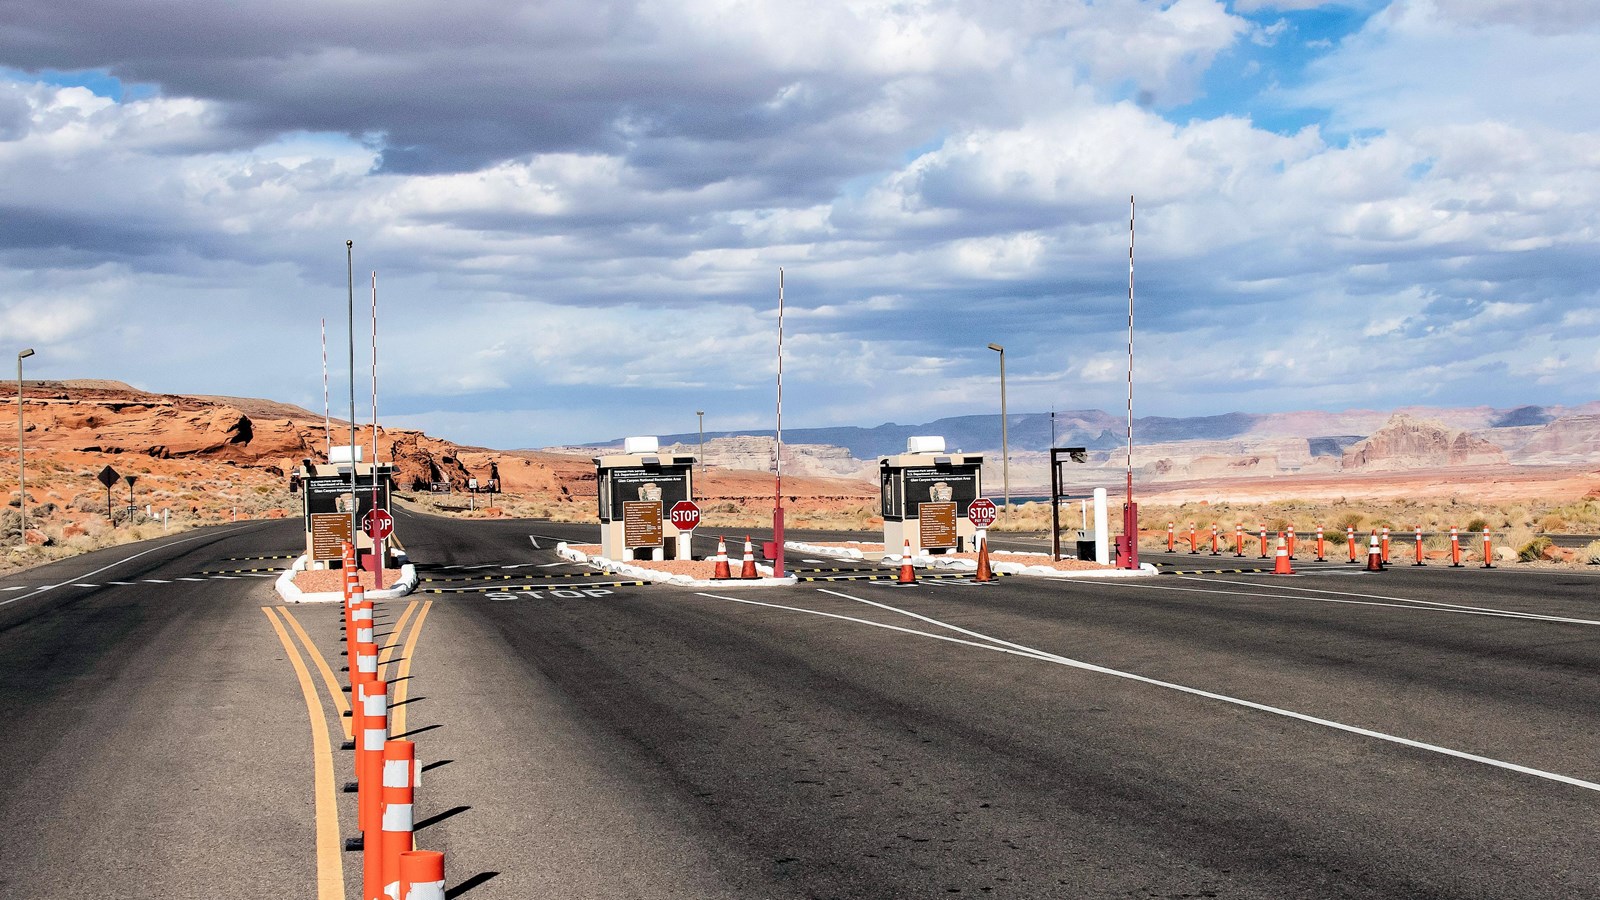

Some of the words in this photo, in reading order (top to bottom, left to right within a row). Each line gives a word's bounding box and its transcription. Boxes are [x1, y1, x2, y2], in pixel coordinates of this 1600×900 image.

[672, 510, 698, 522] STOP
[970, 507, 995, 519] STOP
[485, 589, 614, 600] STOP
